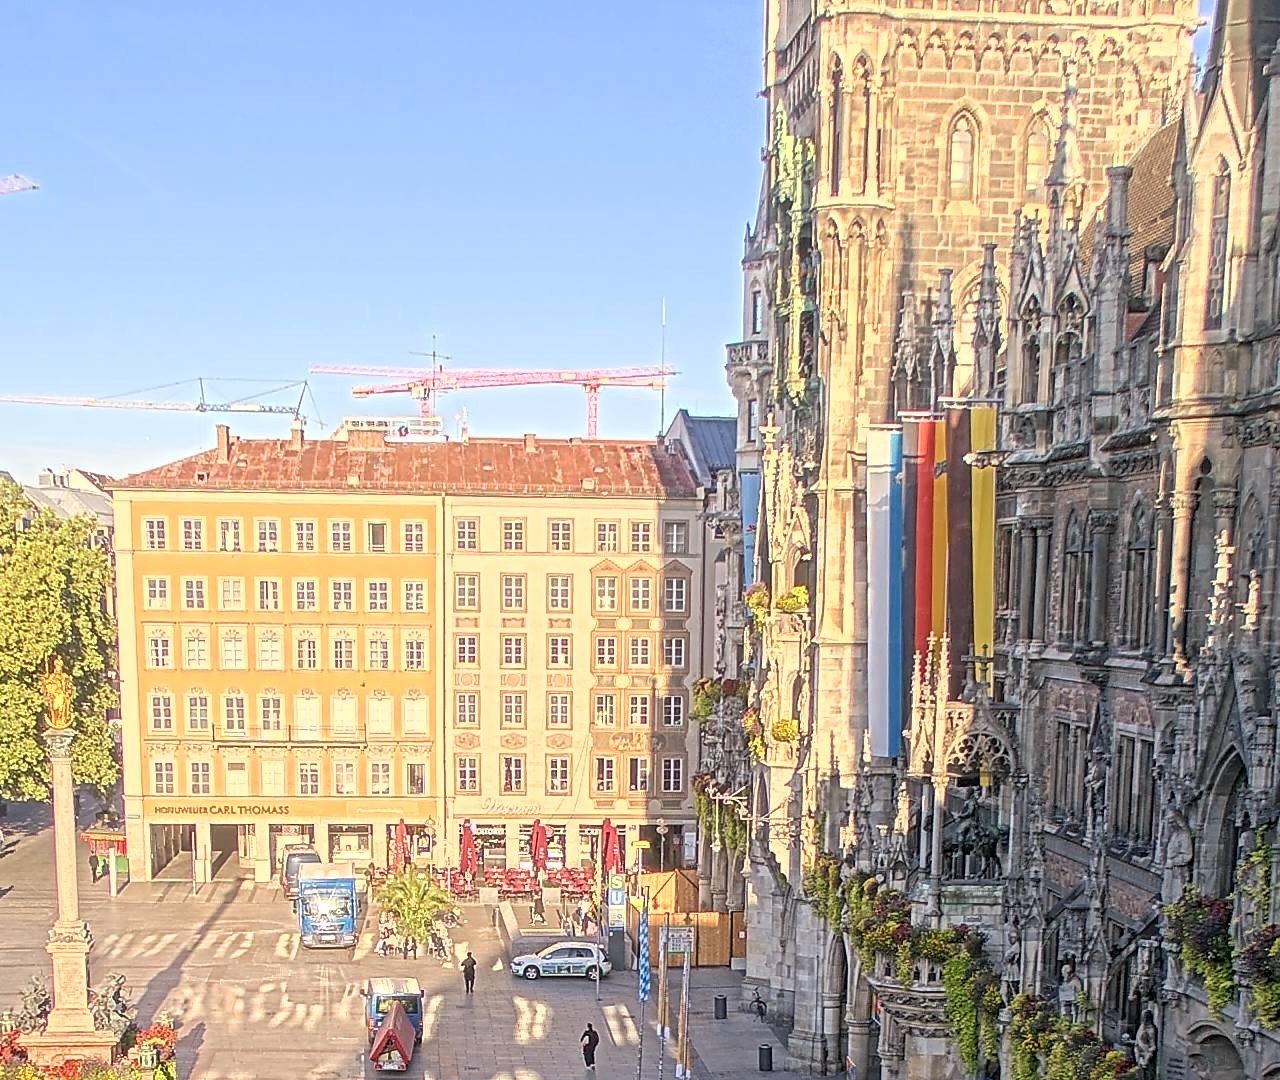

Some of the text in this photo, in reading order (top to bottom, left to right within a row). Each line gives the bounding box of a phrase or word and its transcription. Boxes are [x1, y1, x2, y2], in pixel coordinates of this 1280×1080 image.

[209, 805, 236, 815] CARL
[237, 805, 290, 815] THOMASS
[611, 876, 624, 890] S
